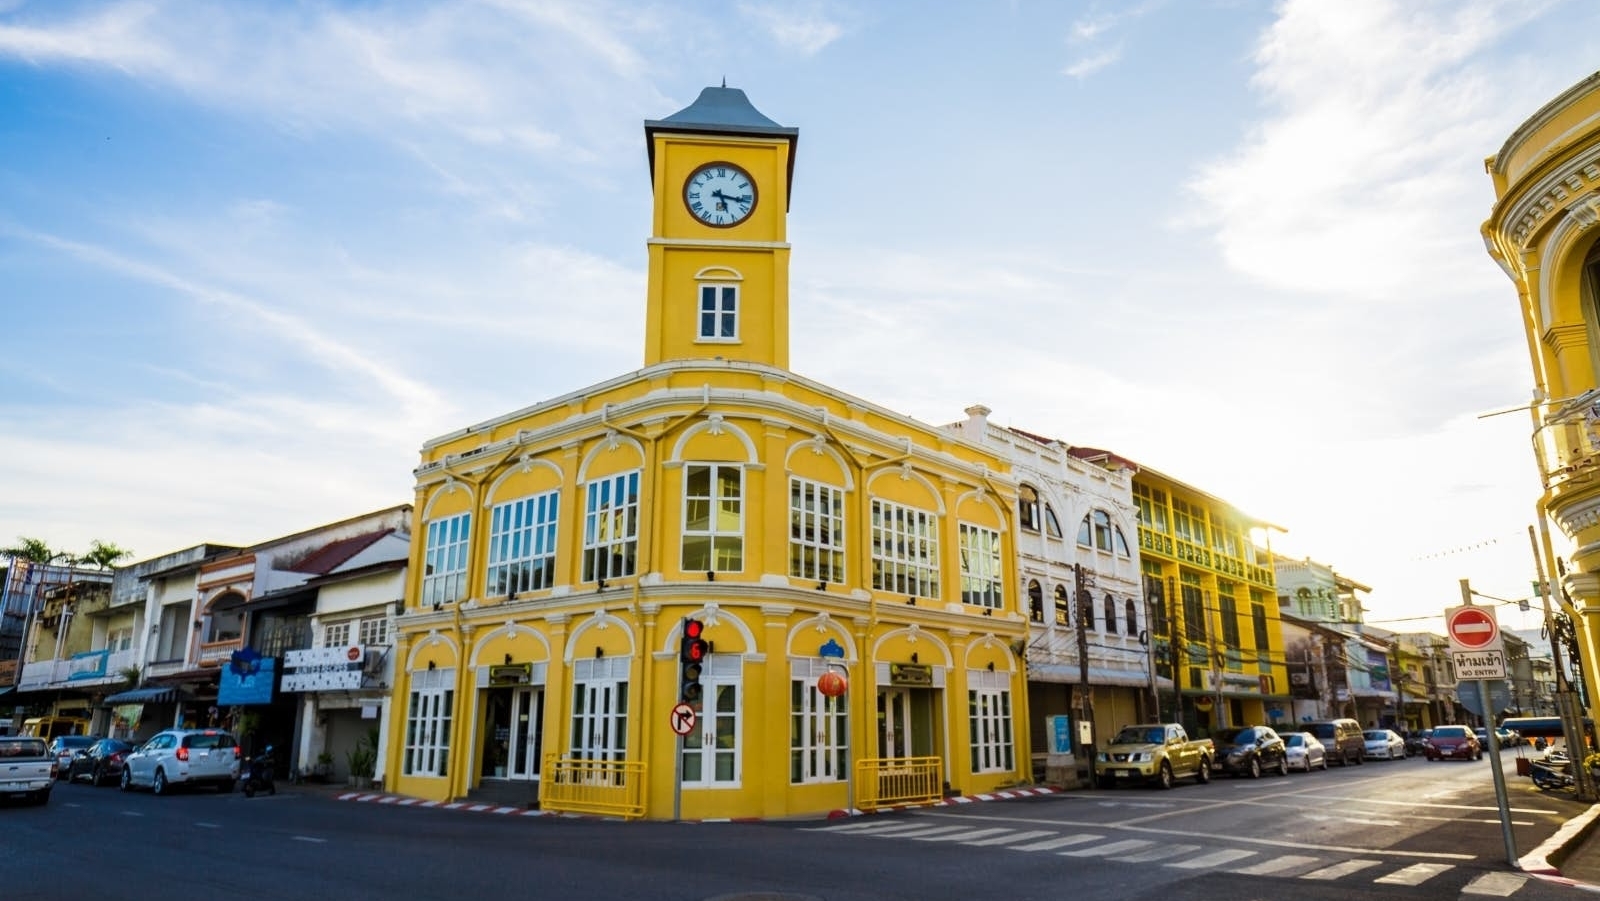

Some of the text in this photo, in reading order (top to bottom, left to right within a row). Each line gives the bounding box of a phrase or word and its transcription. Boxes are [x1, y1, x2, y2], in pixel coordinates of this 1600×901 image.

[716, 168, 726, 178] XII
[692, 642, 700, 659] 6
[1456, 652, 1501, 667] ห้ามเข้า
